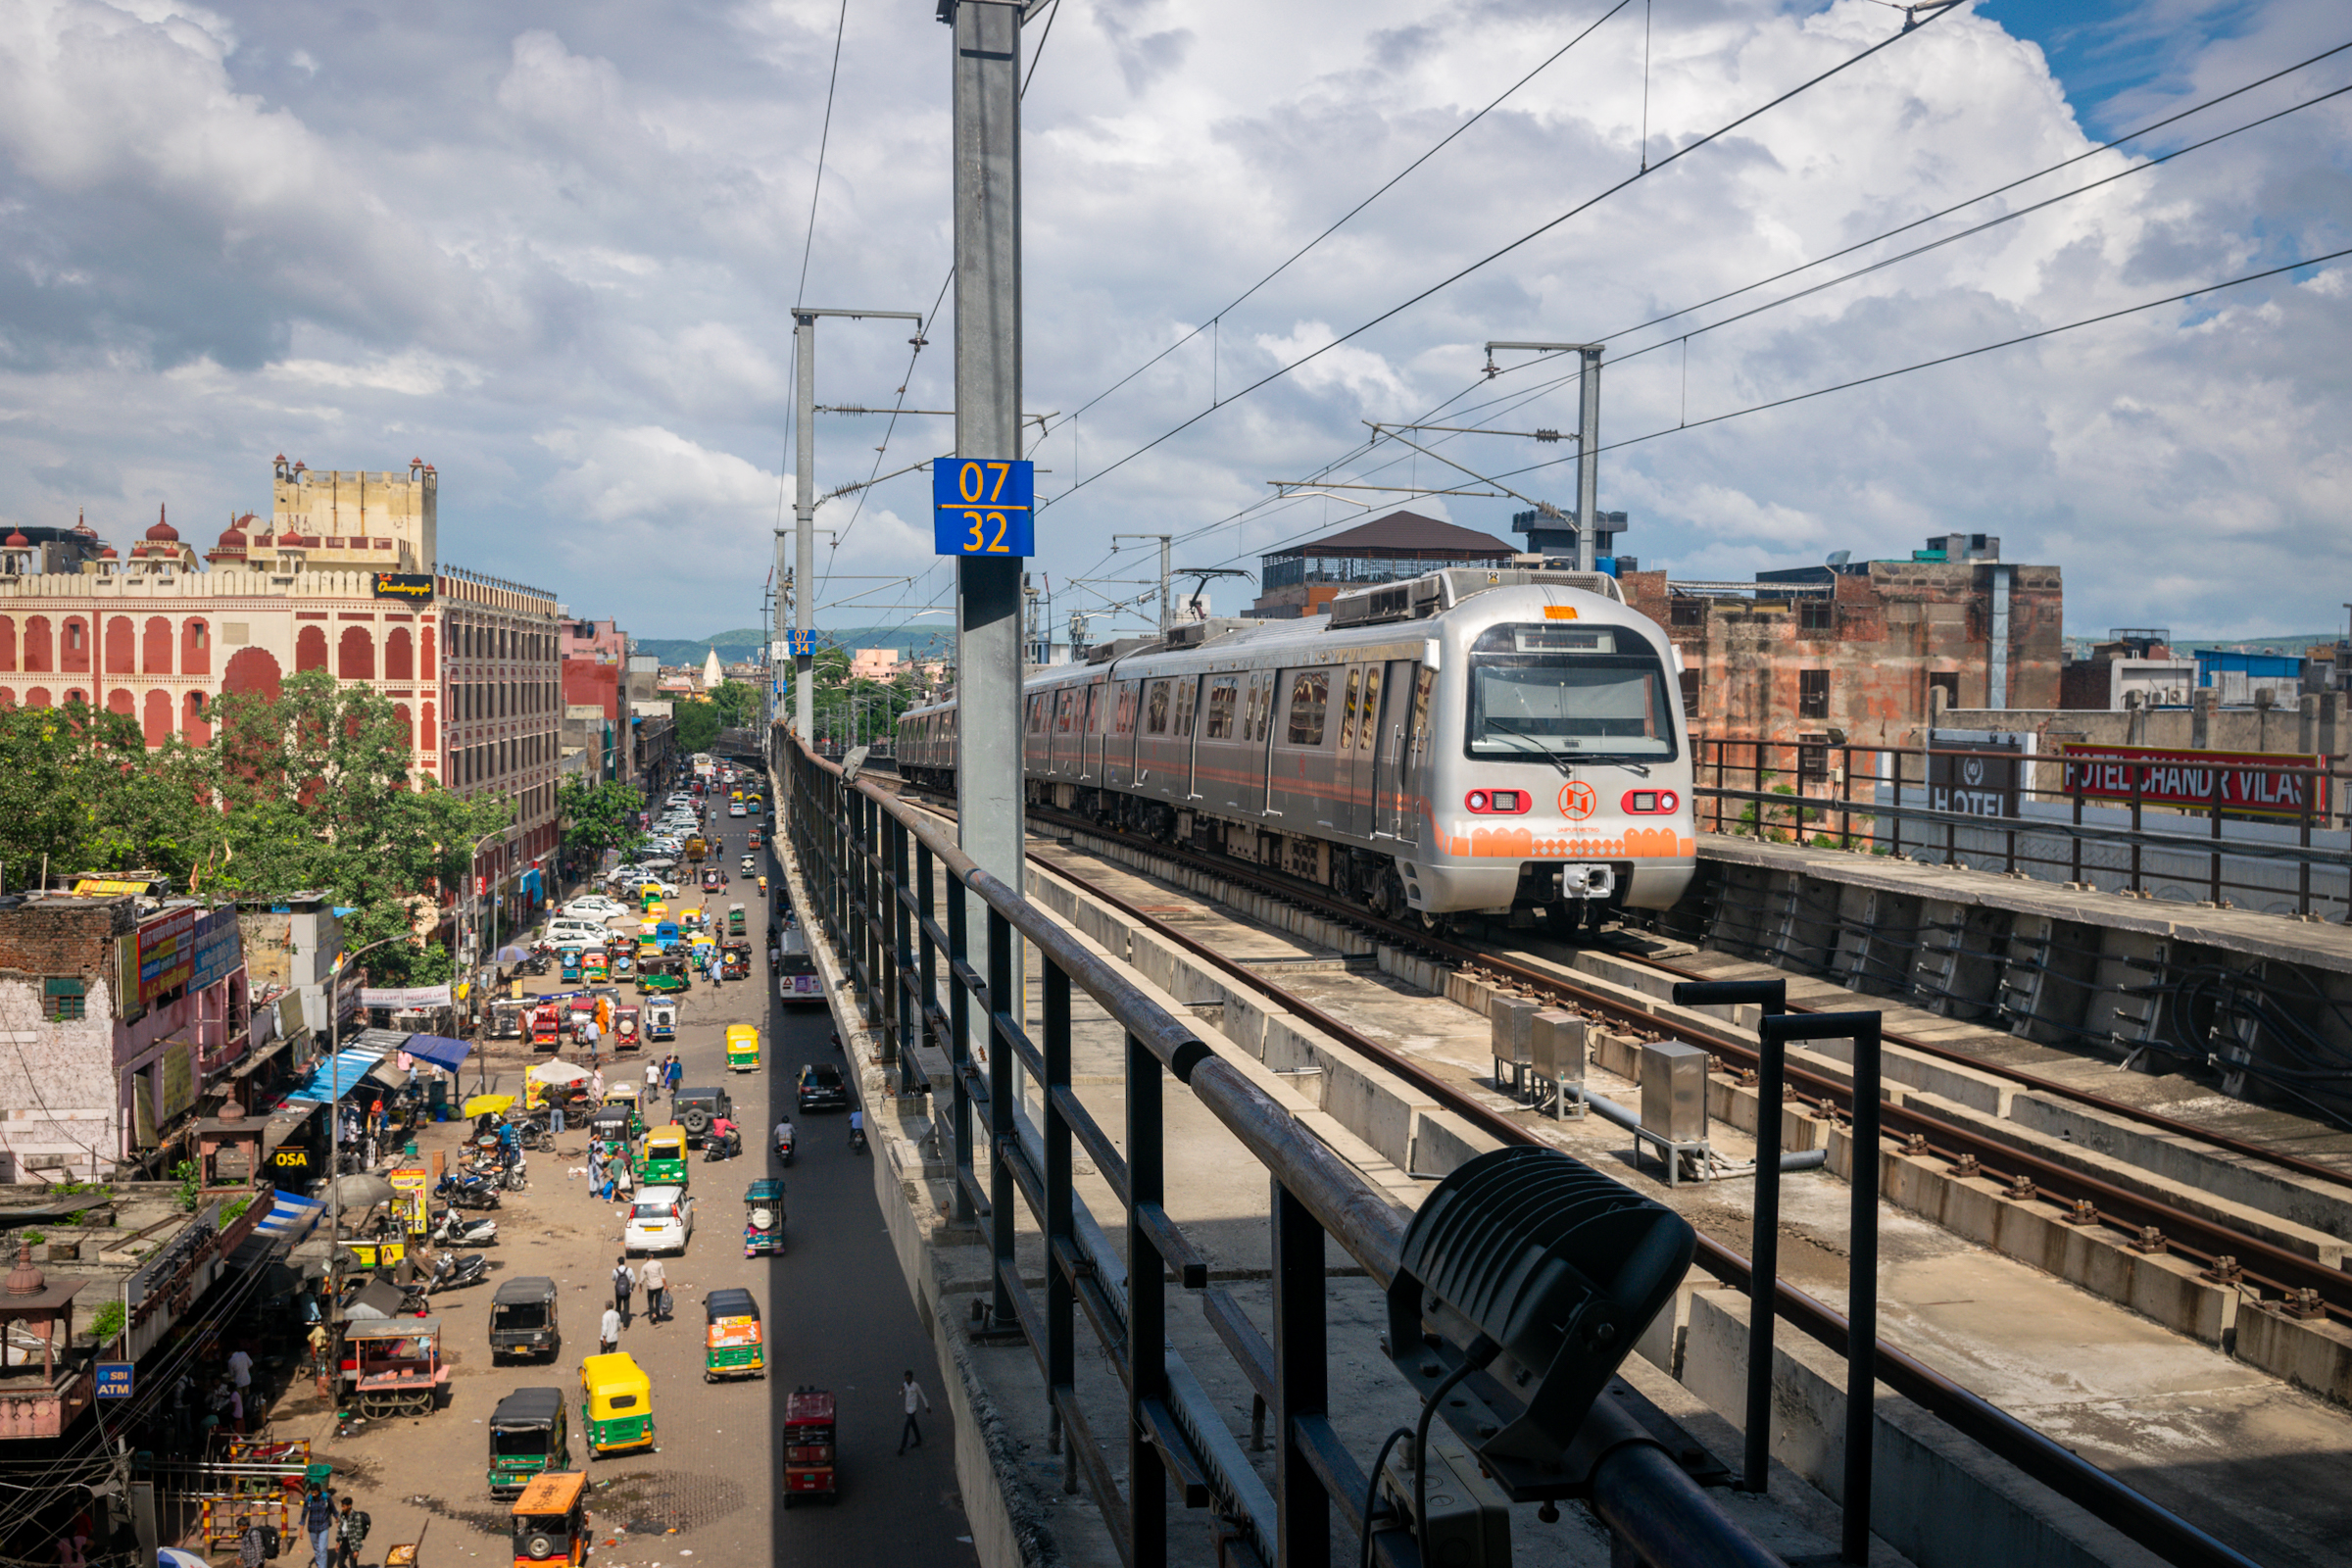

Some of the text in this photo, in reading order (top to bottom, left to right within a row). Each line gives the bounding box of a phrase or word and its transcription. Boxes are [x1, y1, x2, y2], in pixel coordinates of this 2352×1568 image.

[958, 462, 1010, 503] 07
[963, 511, 1009, 553] 32
[794, 630, 808, 641] 07
[795, 643, 809, 655] 34
[2065, 752, 2132, 792] HOTEL
[2238, 761, 2310, 806] VILAS
[110, 1371, 128, 1381] SBI
[97, 1384, 129, 1395] ATM
